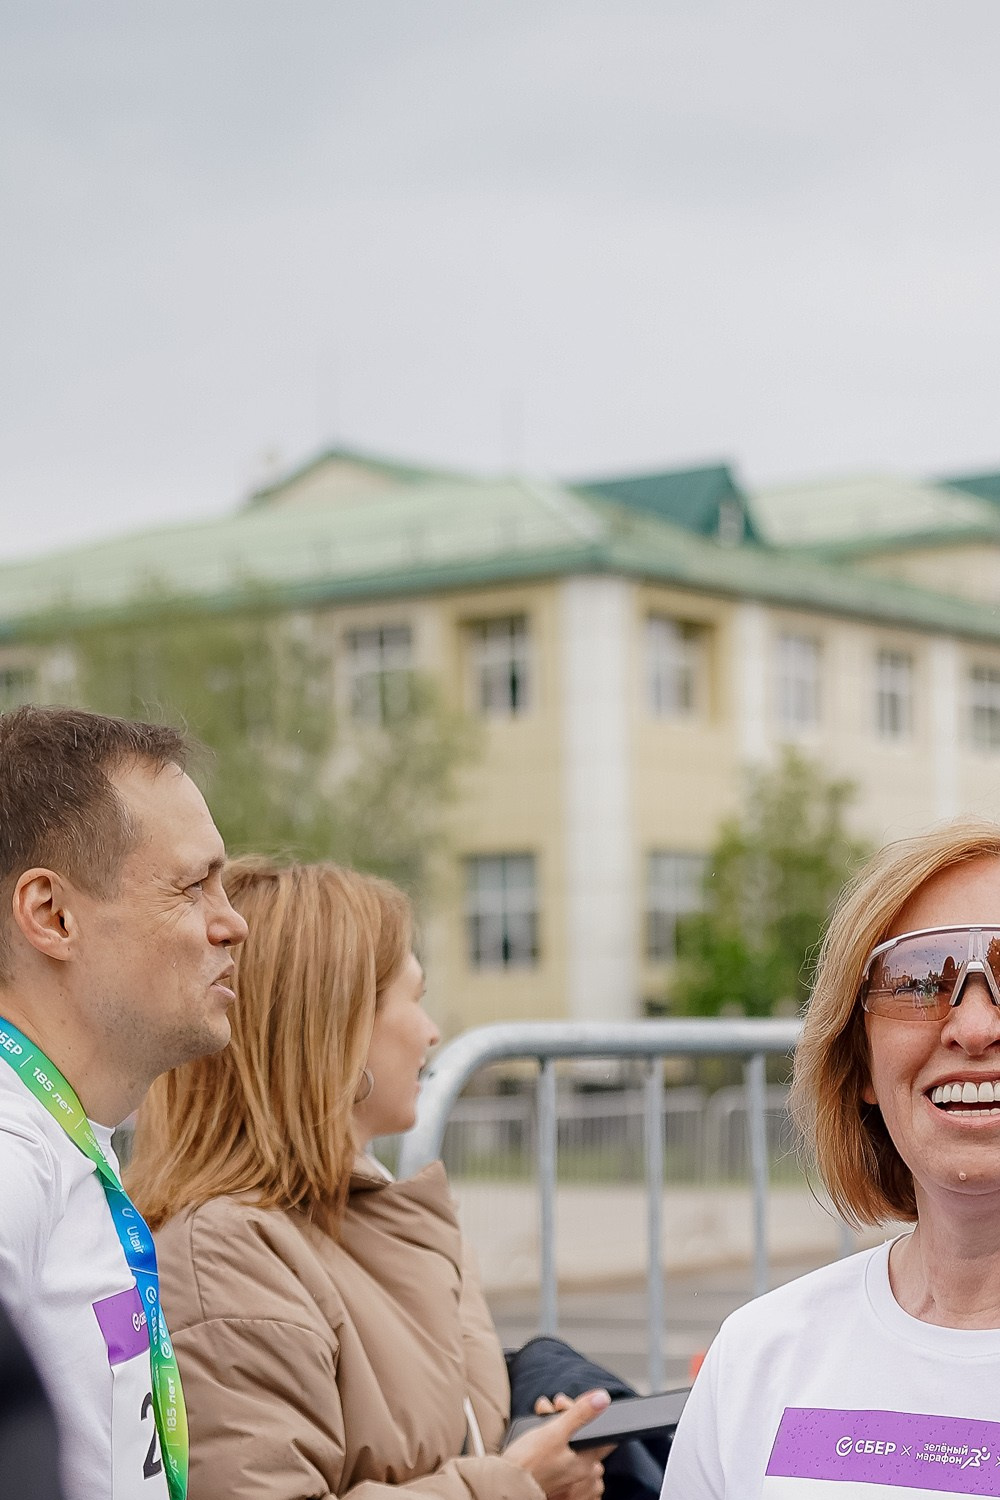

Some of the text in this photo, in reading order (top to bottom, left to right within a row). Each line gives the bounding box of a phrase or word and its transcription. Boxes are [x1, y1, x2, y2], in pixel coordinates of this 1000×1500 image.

[0, 1029, 74, 1115] БЕР 185 лет
[126, 1225, 144, 1254] Utair
[166, 1377, 177, 1432] 185 лет
[854, 1439, 897, 1456] СБЕР
[916, 1451, 963, 1465] марафон
[923, 1442, 969, 1456] зелёный
